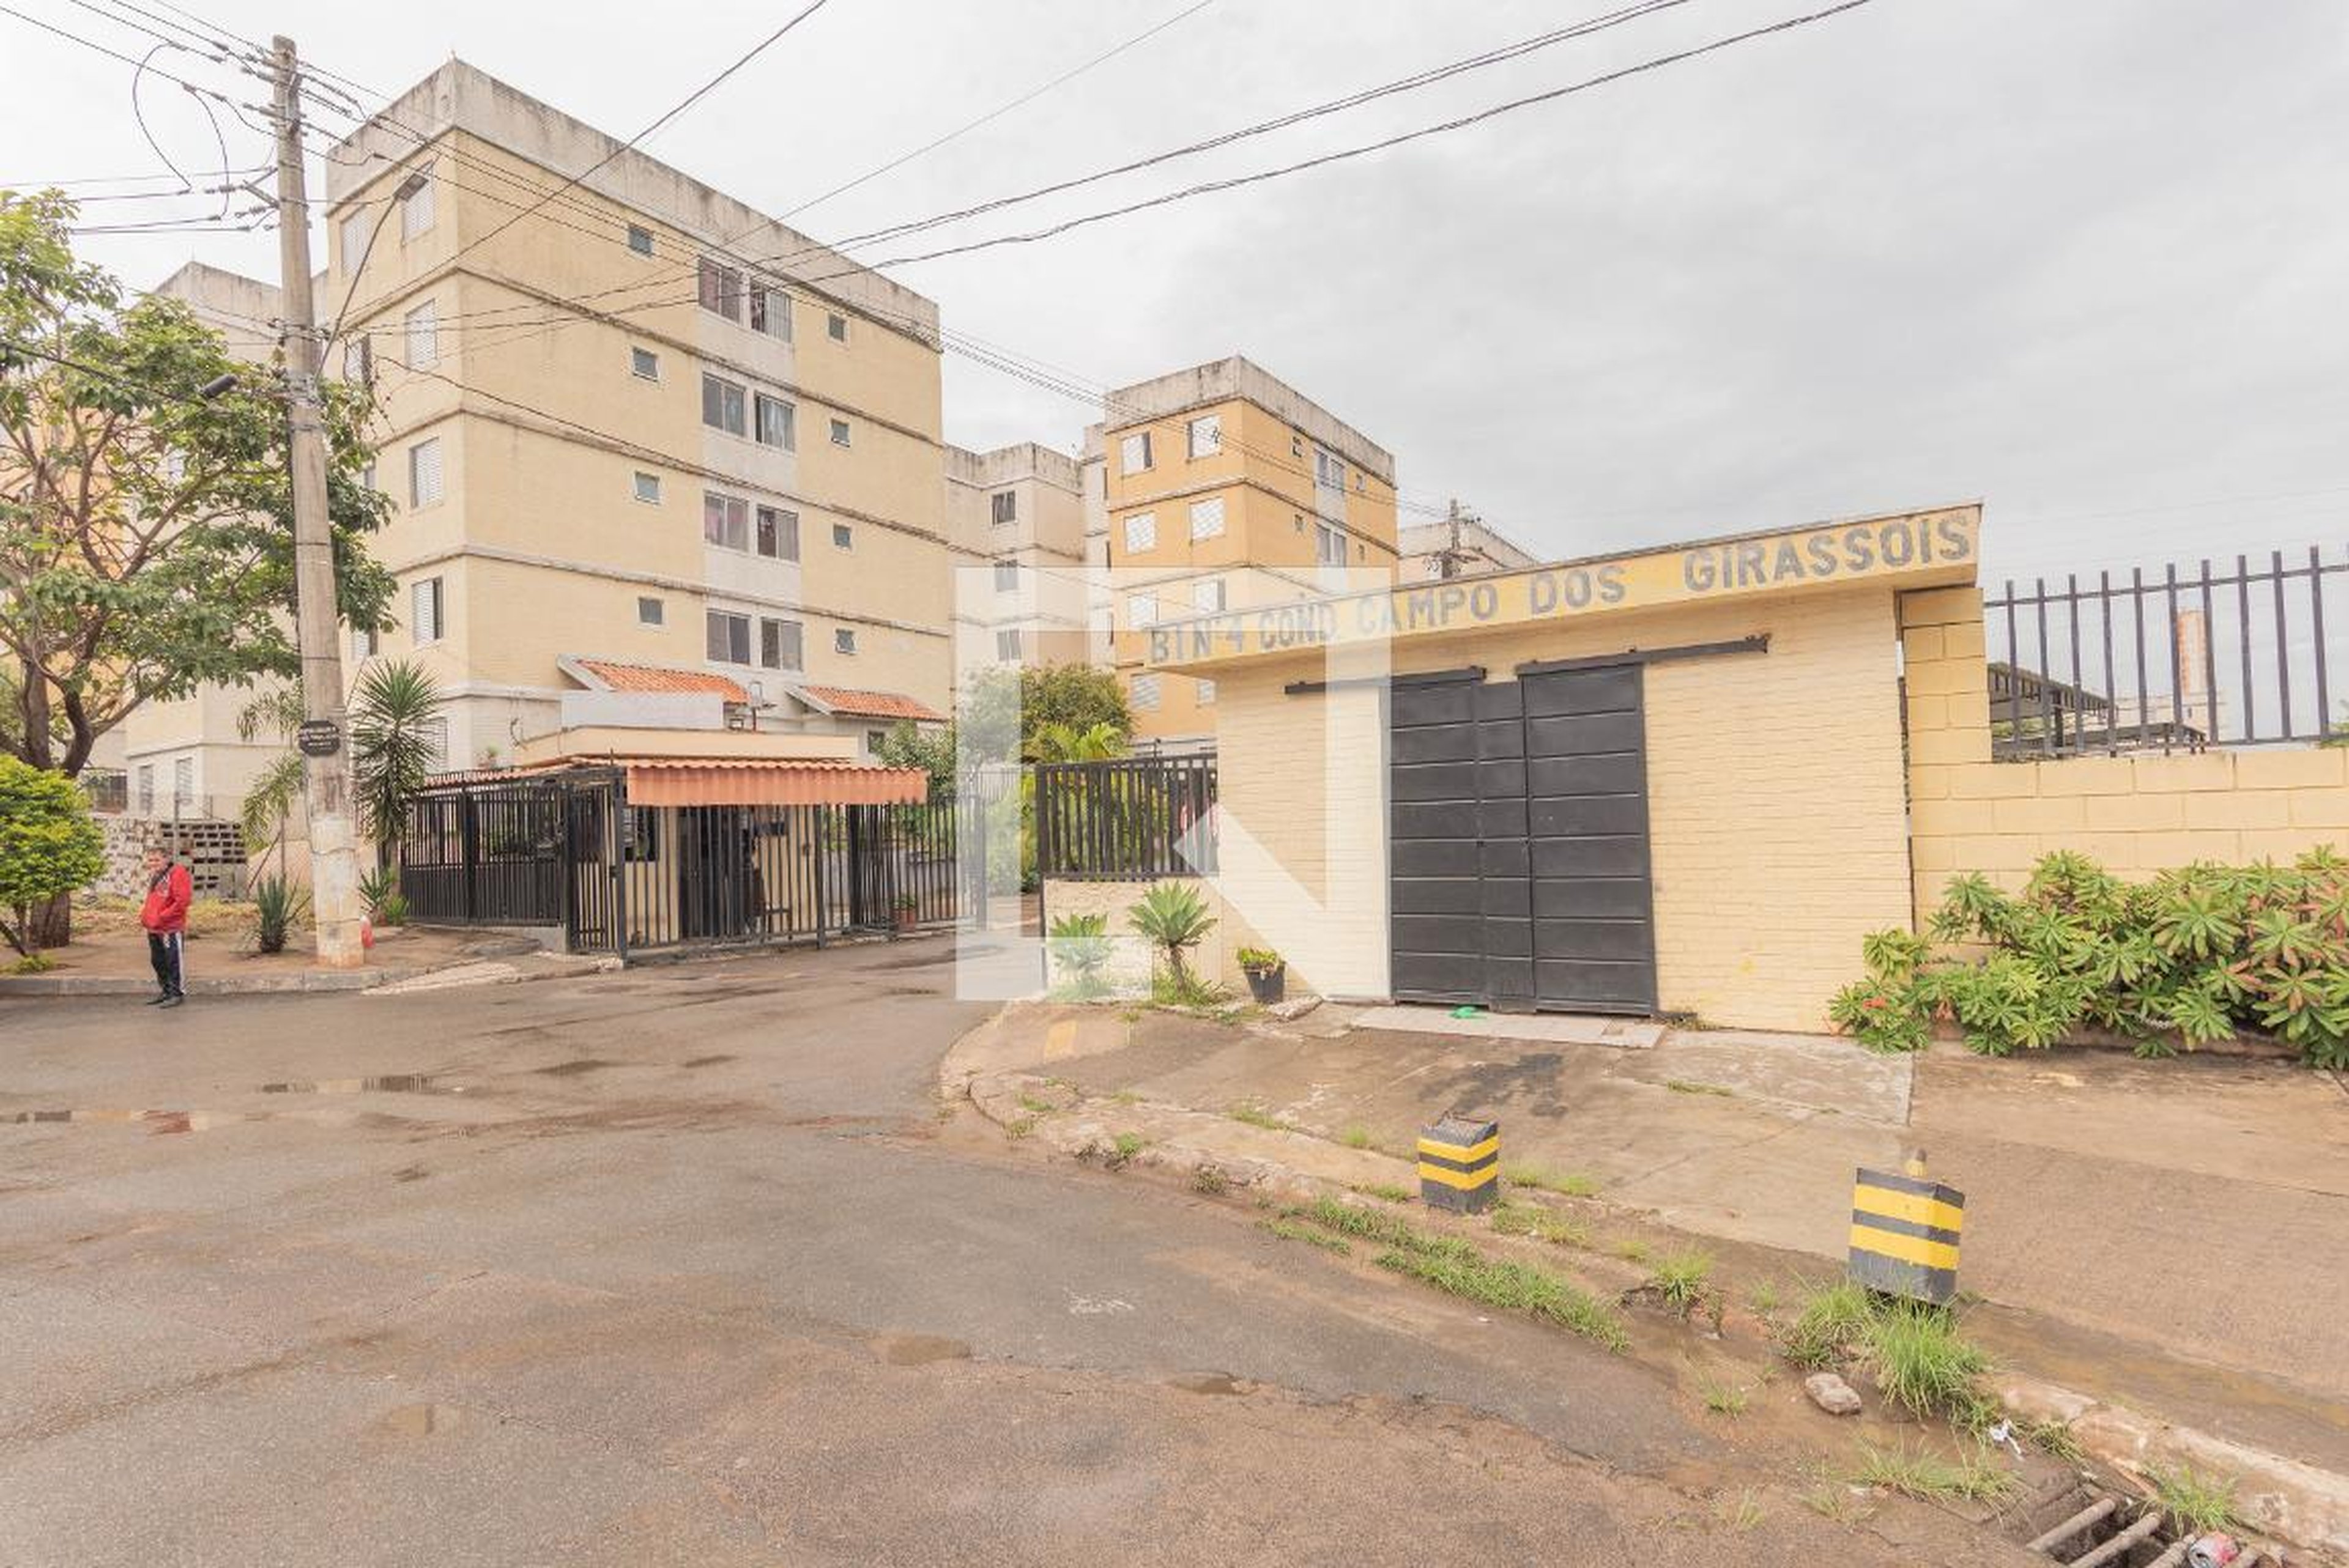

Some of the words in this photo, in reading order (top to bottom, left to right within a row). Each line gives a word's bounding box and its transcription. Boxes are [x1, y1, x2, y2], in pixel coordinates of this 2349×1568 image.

[1356, 583, 1499, 633] CAMPO
[1530, 564, 1626, 613] DOS
[1683, 515, 1970, 591] GIRASSOIS
